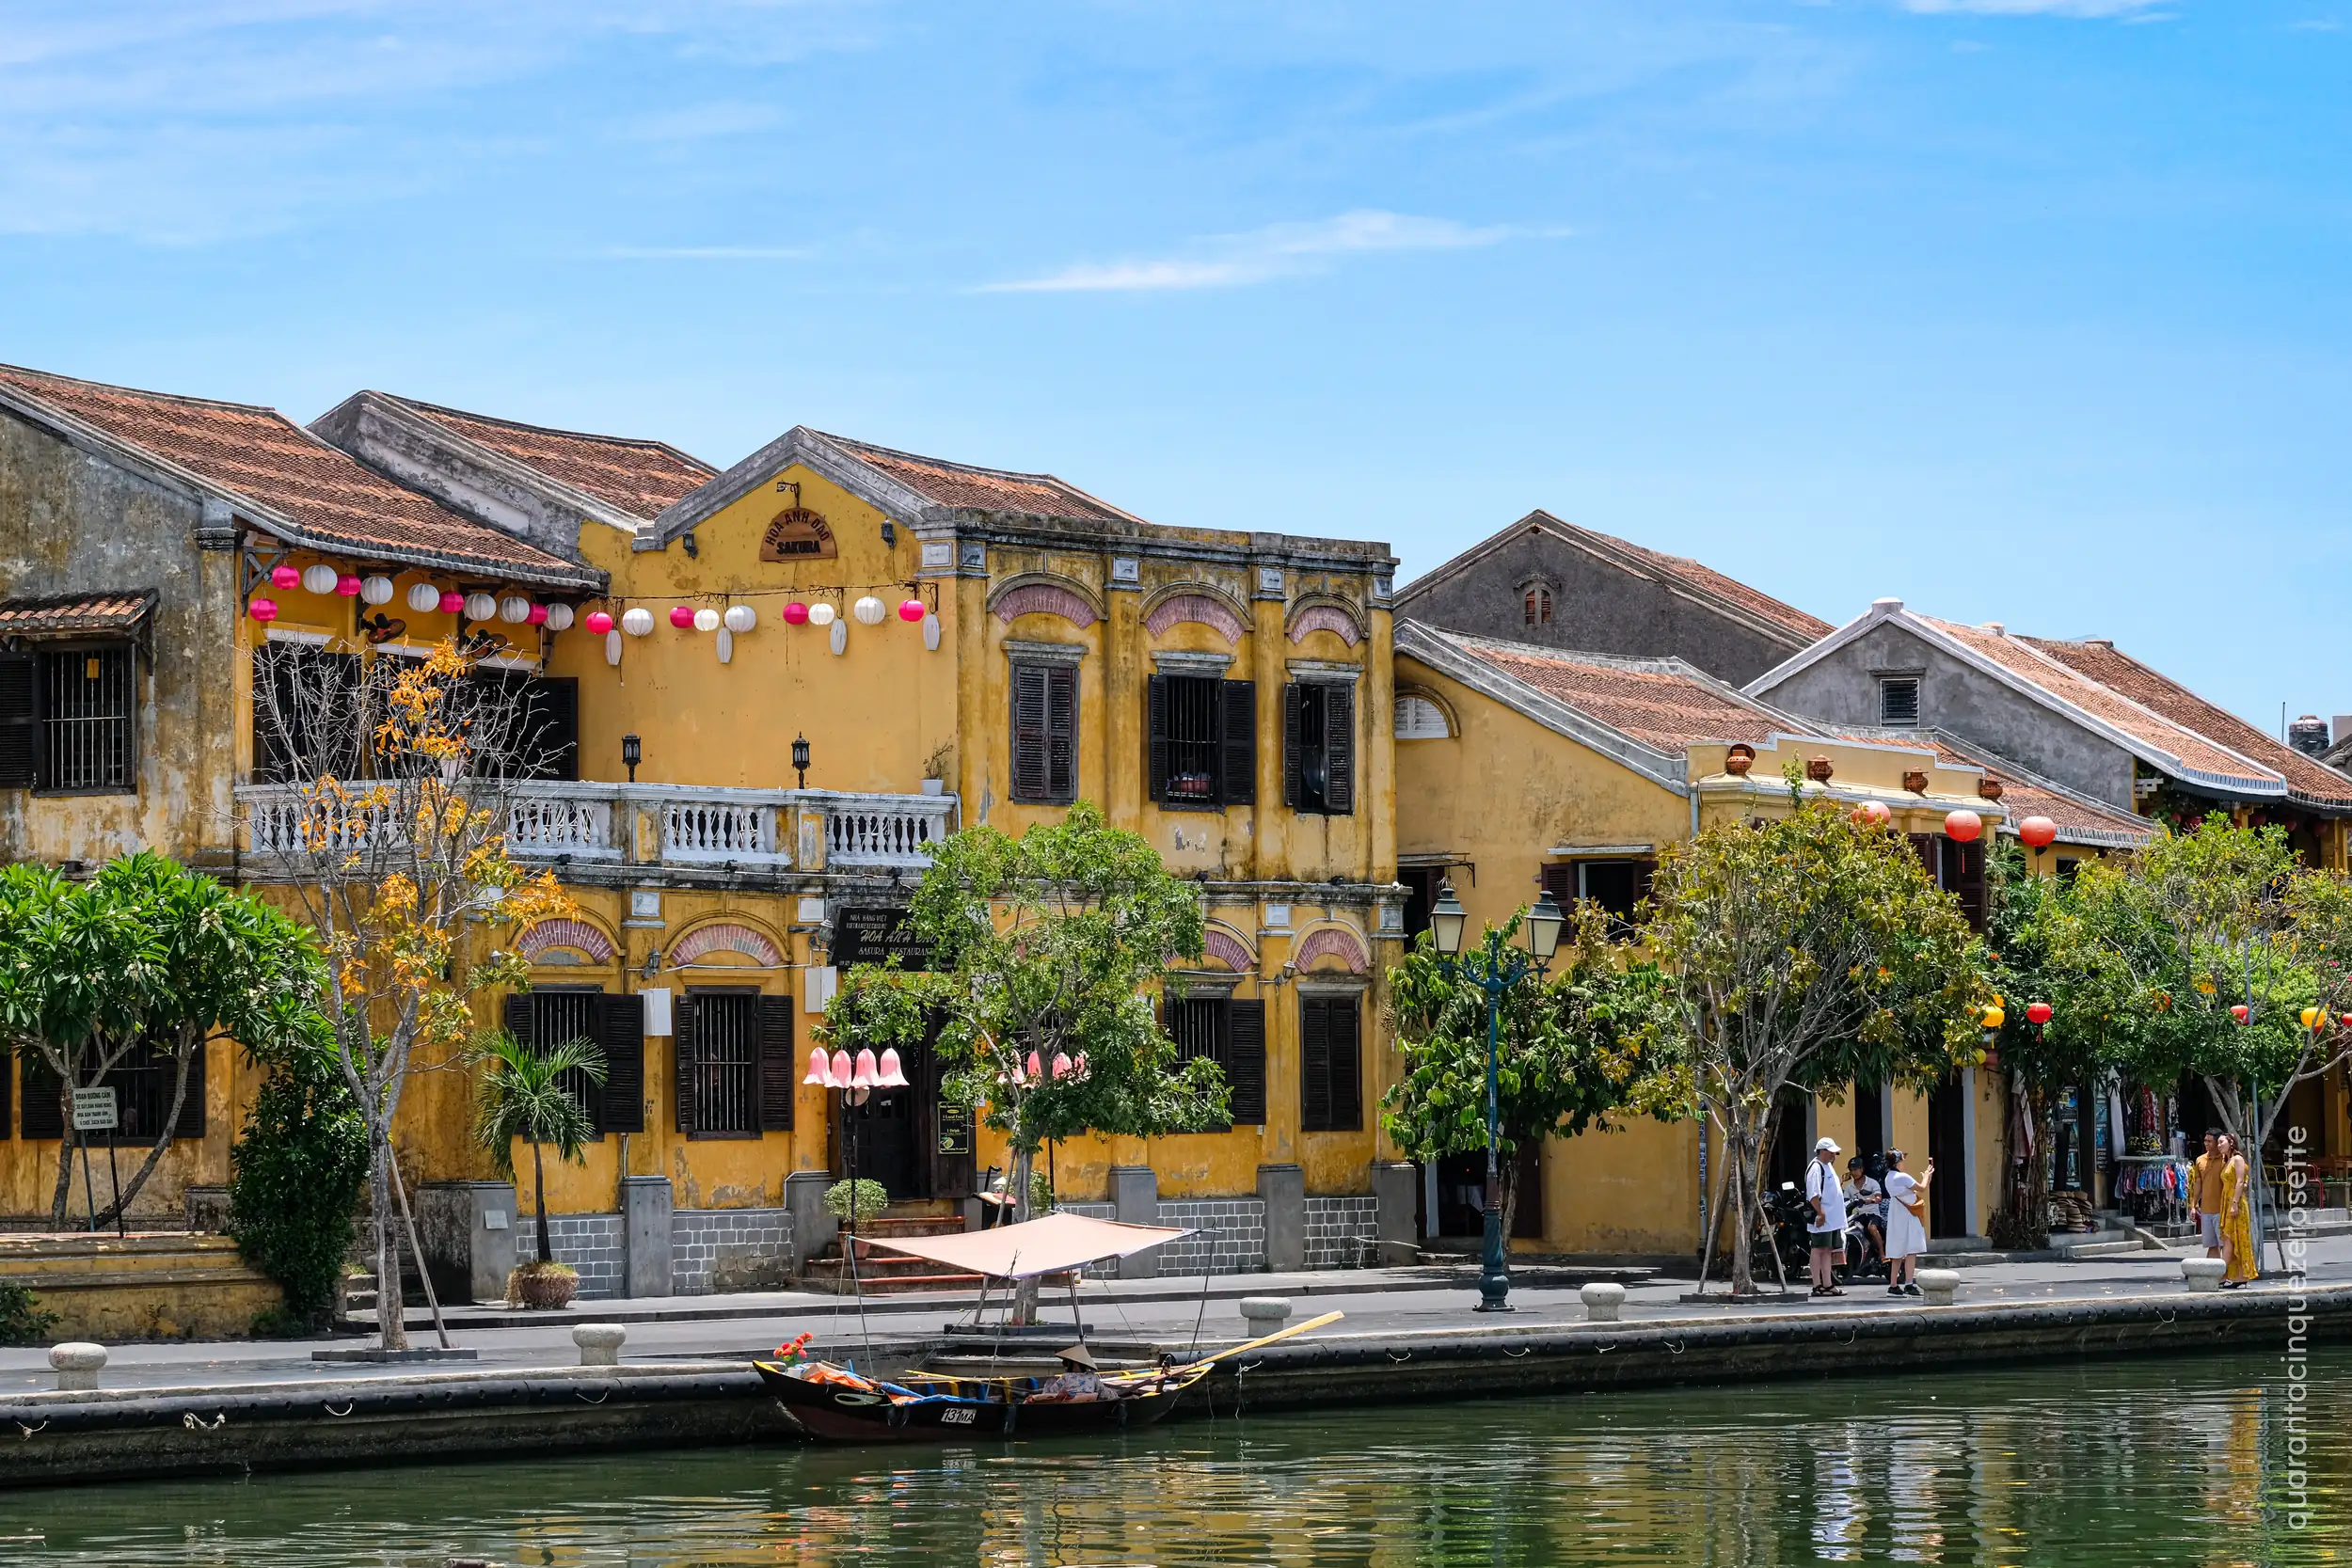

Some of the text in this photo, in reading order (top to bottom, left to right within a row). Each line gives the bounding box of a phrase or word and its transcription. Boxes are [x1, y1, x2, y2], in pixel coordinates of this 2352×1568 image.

[765, 521, 785, 546] HOA
[785, 510, 810, 525] ANH
[776, 540, 820, 555] SAKURA
[860, 929, 883, 942] HOA
[884, 929, 912, 942] ANH
[858, 946, 884, 956] SAKURA
